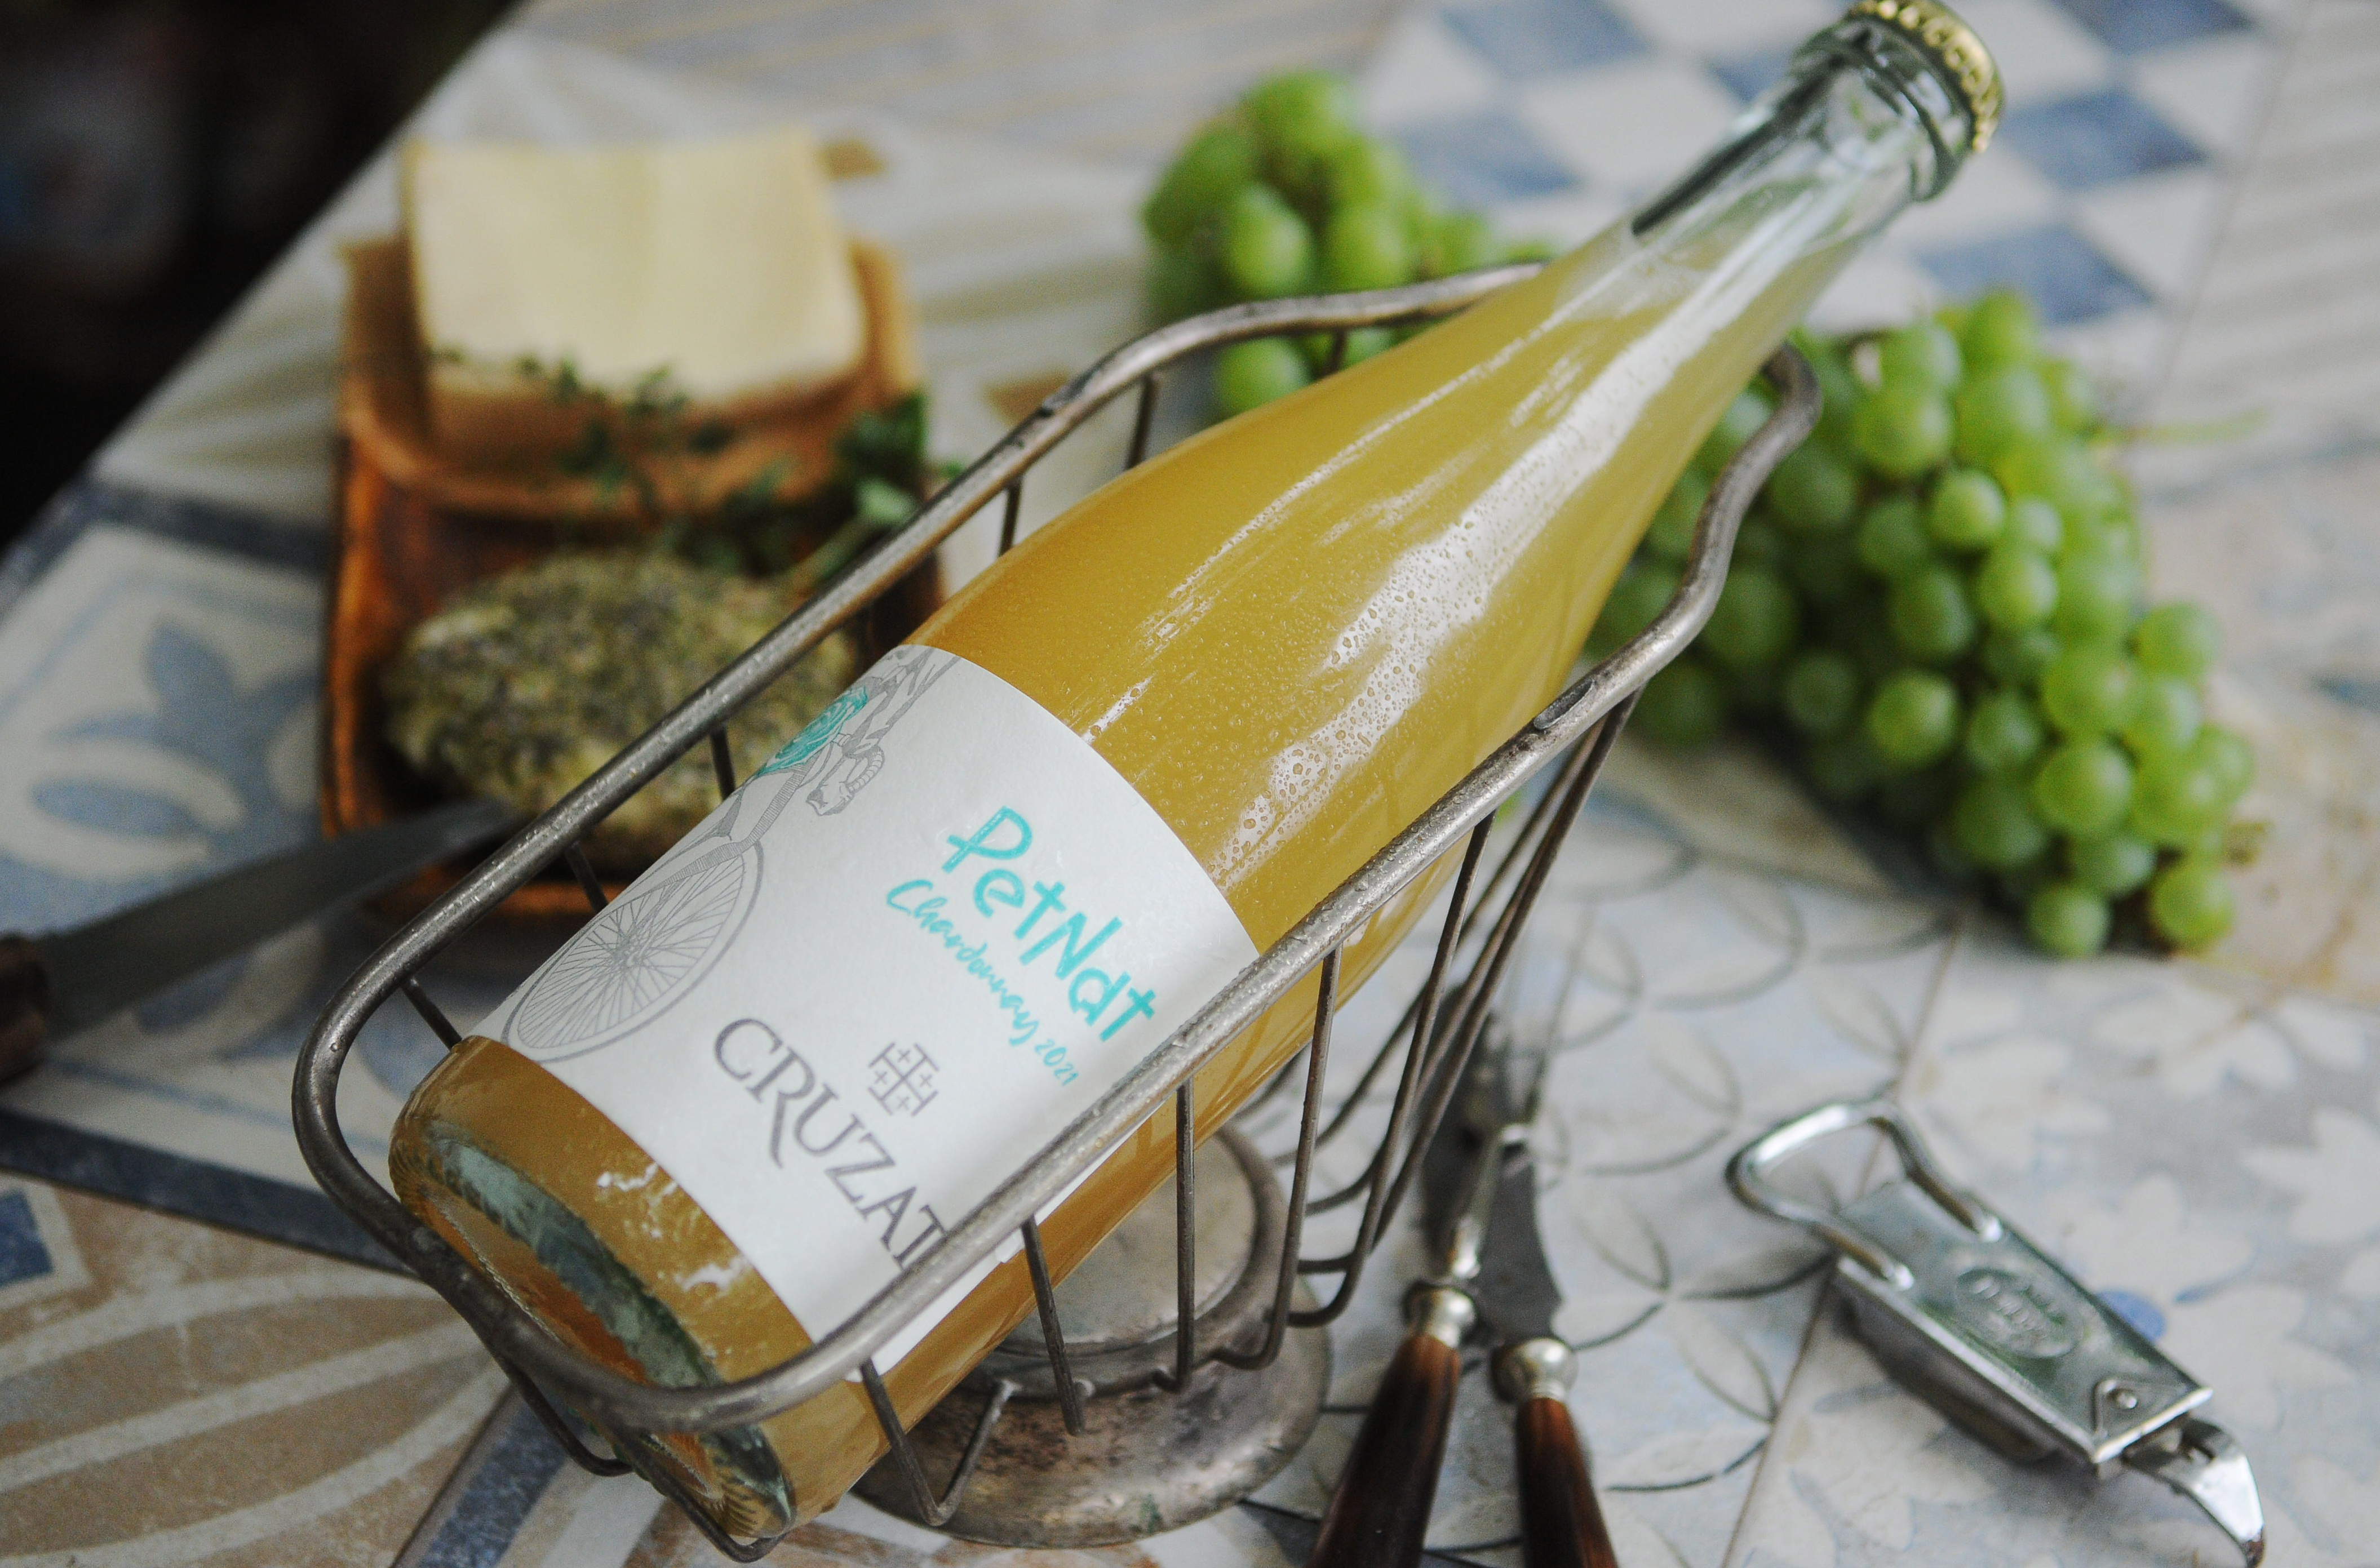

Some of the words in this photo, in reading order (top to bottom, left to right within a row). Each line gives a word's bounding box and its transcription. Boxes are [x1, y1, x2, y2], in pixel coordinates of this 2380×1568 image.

[886, 878, 1040, 1046] Chardonnay
[1034, 1039, 1079, 1086] 2021
[712, 1017, 947, 1270] CRUZAT
